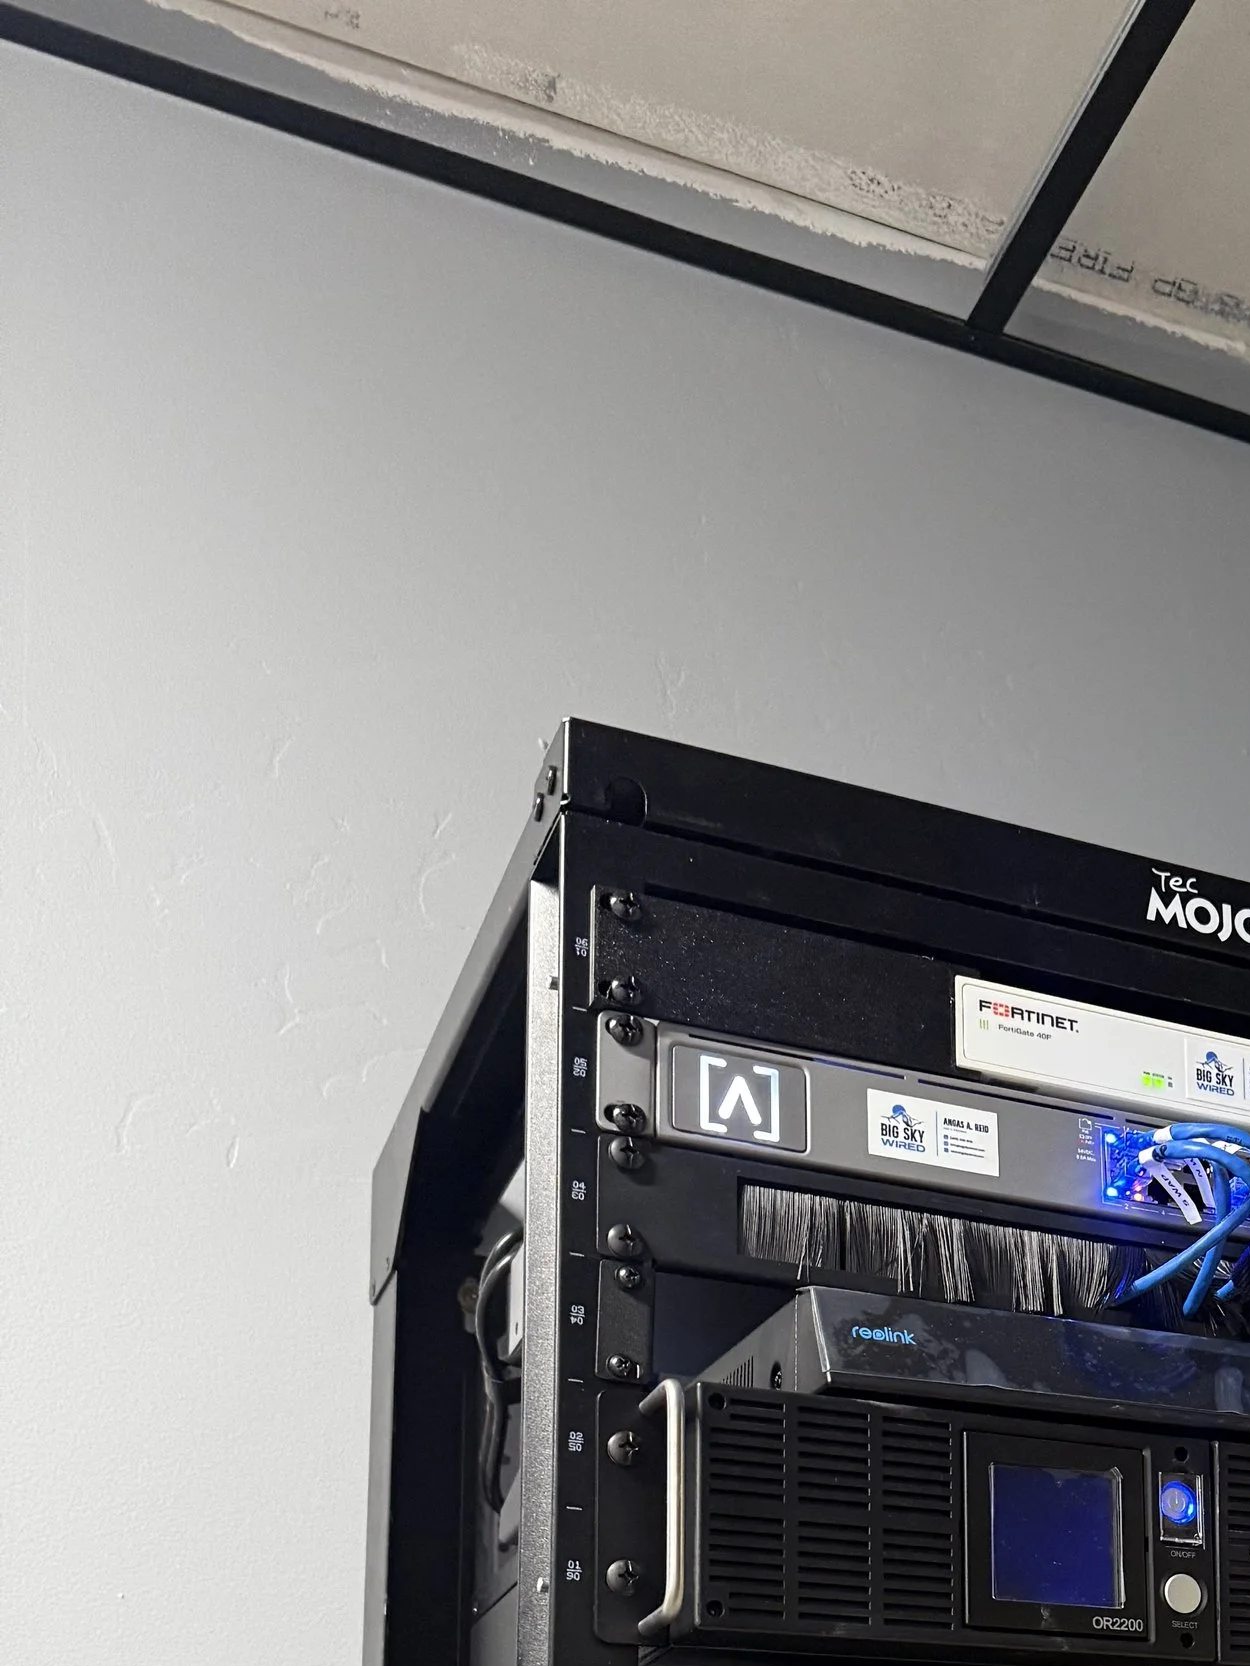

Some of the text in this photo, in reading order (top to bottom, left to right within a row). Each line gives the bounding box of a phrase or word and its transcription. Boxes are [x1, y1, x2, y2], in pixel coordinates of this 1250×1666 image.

[1051, 239, 1135, 283] FIRE
[1152, 868, 1198, 893] Tec
[998, 1024, 1034, 1038] FortiGate
[1196, 1068, 1234, 1088] BIG SKY
[1196, 1082, 1235, 1096] WIRED
[943, 1117, 964, 1129] ANGAS
[881, 1123, 925, 1143] BIG SKY
[880, 1138, 926, 1152] WIRED
[1161, 1174, 1182, 1198] WAP
[851, 1326, 917, 1345] reolink
[1170, 1550, 1196, 1559] ON/OFF
[1092, 1616, 1144, 1632] OR2200
[1172, 1620, 1198, 1629] SELECT
